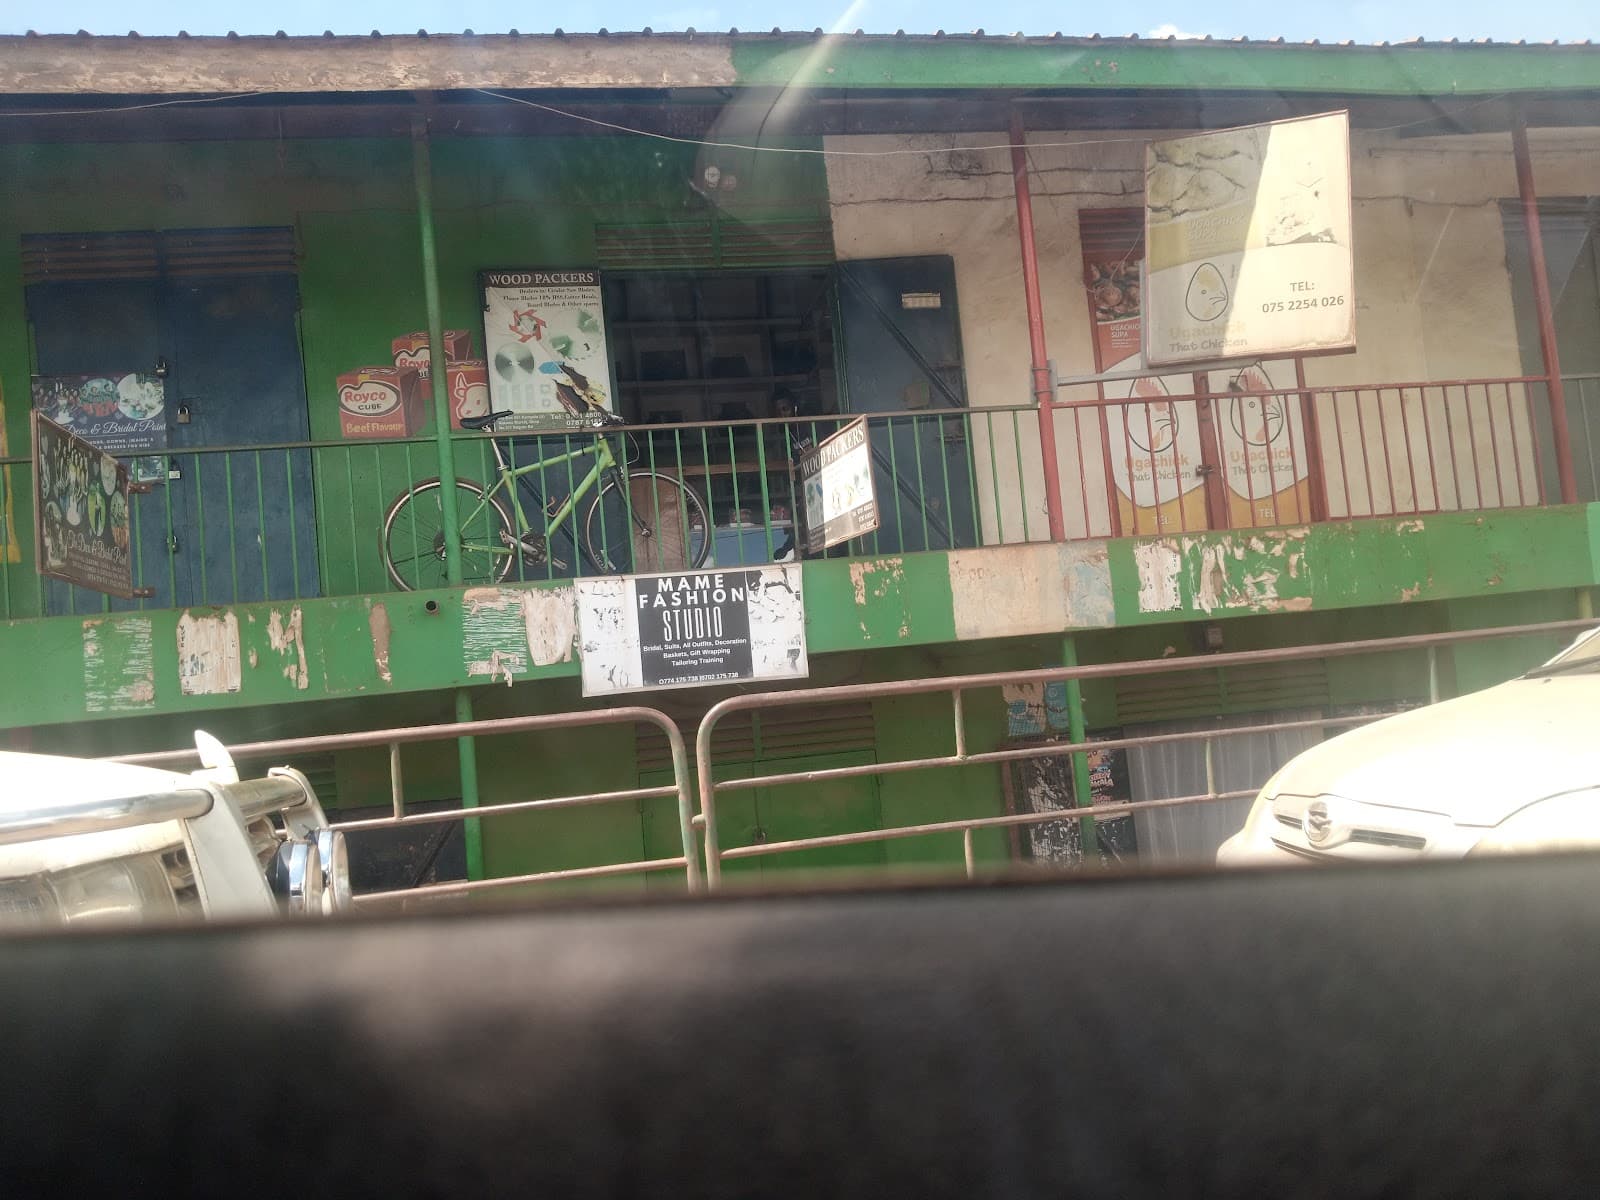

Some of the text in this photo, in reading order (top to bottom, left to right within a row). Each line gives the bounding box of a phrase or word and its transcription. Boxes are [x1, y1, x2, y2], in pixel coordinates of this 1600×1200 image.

[489, 272, 594, 286] WOOD PACKERS
[1289, 281, 1316, 293] TEL:
[1262, 295, 1345, 313] 075 2254 026
[1169, 343, 1198, 353] That
[344, 391, 386, 403] Royco
[357, 403, 382, 411] CUBE
[346, 422, 371, 433] Beef
[803, 423, 864, 477] WOOD PACKERS
[658, 573, 725, 593] MAME
[639, 587, 745, 609] FASHION
[662, 606, 723, 642] STUDIO
[691, 640, 714, 648] Outfits,
[714, 638, 747, 646] Decoration
[701, 647, 731, 656] Wrapping
[671, 656, 724, 667] Tailoring Training
